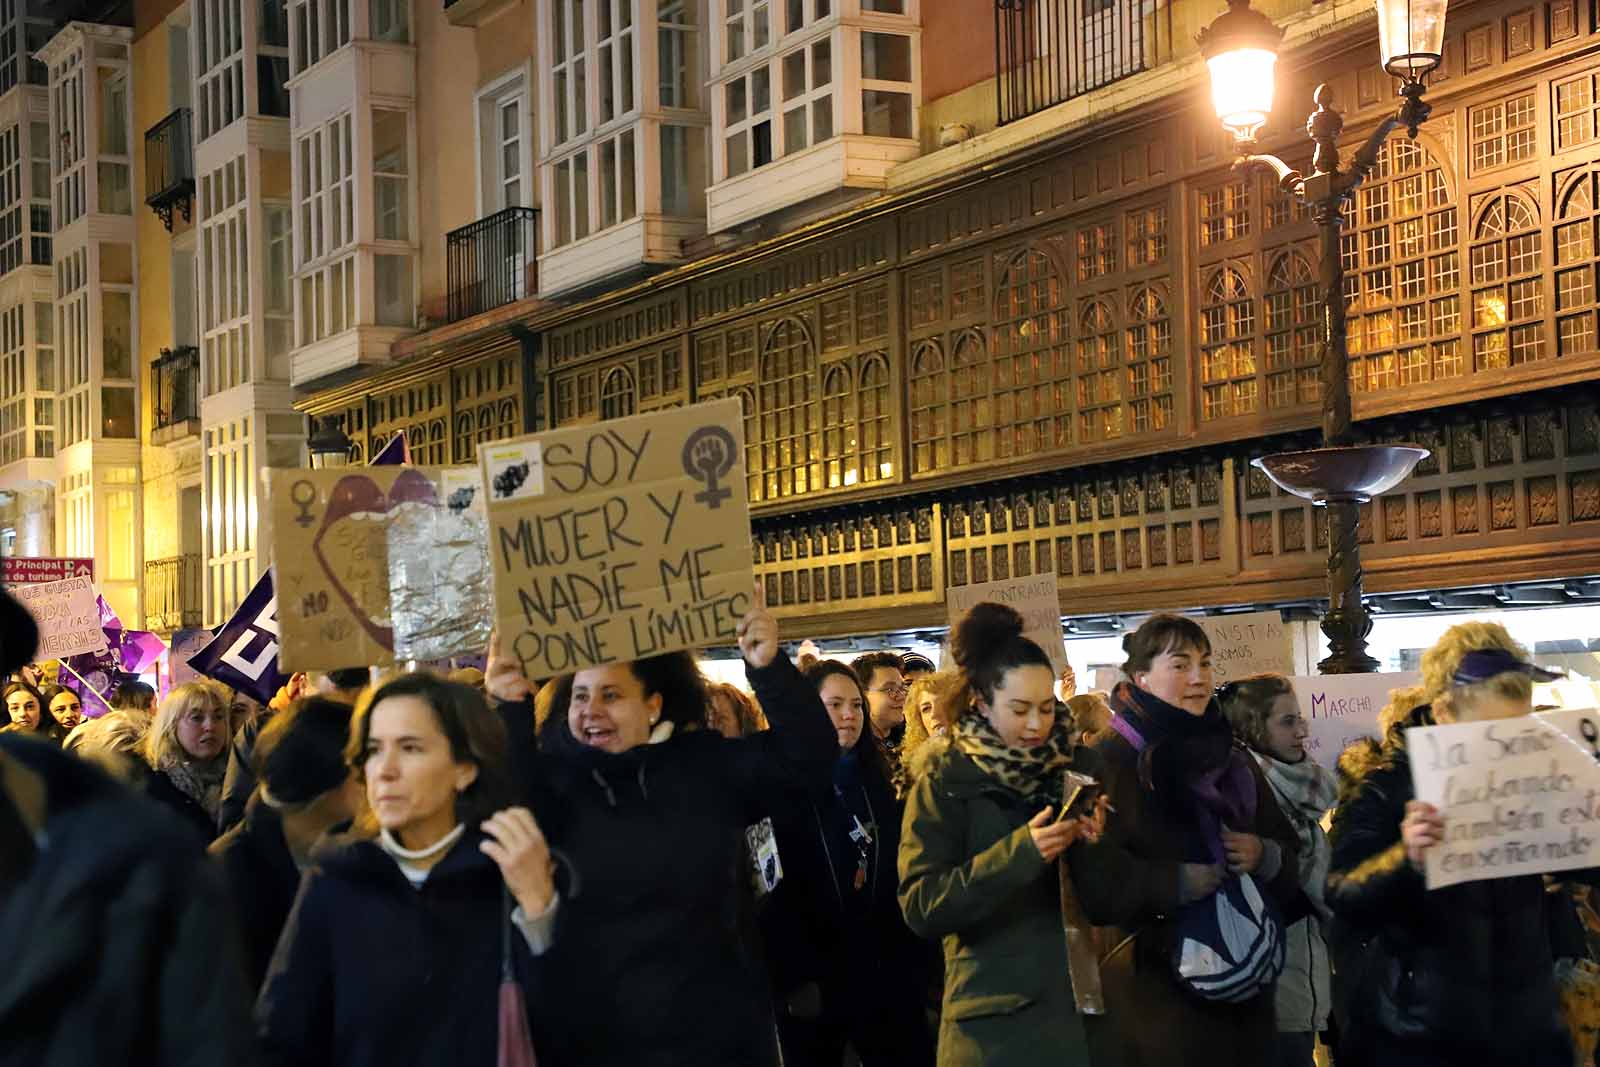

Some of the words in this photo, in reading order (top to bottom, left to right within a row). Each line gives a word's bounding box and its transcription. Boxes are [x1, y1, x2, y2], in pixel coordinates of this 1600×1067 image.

[542, 428, 651, 494] SOY
[499, 496, 644, 573] MUJER
[647, 489, 683, 545] Y
[16, 560, 61, 570] Principal
[658, 543, 724, 604] ME
[512, 618, 617, 678] PONE
